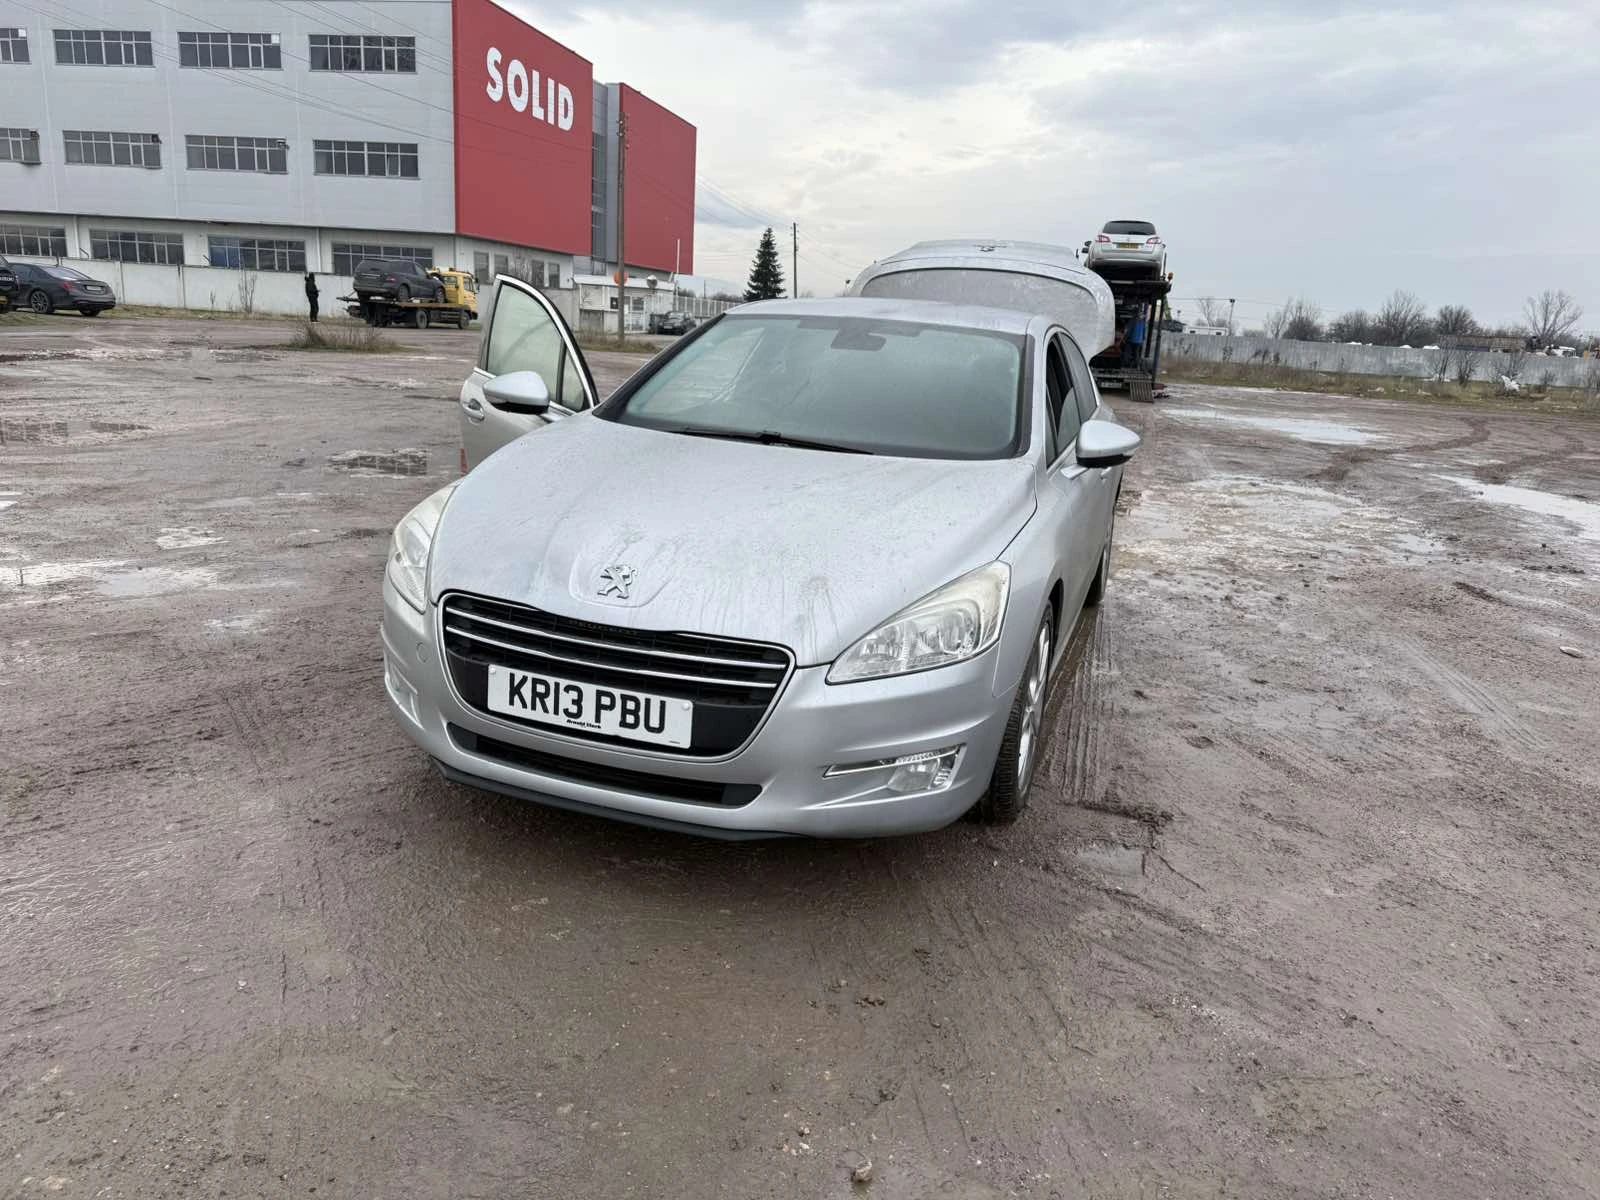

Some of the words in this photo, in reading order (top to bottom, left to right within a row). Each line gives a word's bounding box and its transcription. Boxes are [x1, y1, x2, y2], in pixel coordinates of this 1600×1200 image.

[486, 46, 574, 131] SOLID
[508, 672, 584, 720] KR13
[594, 689, 667, 734] PBU
